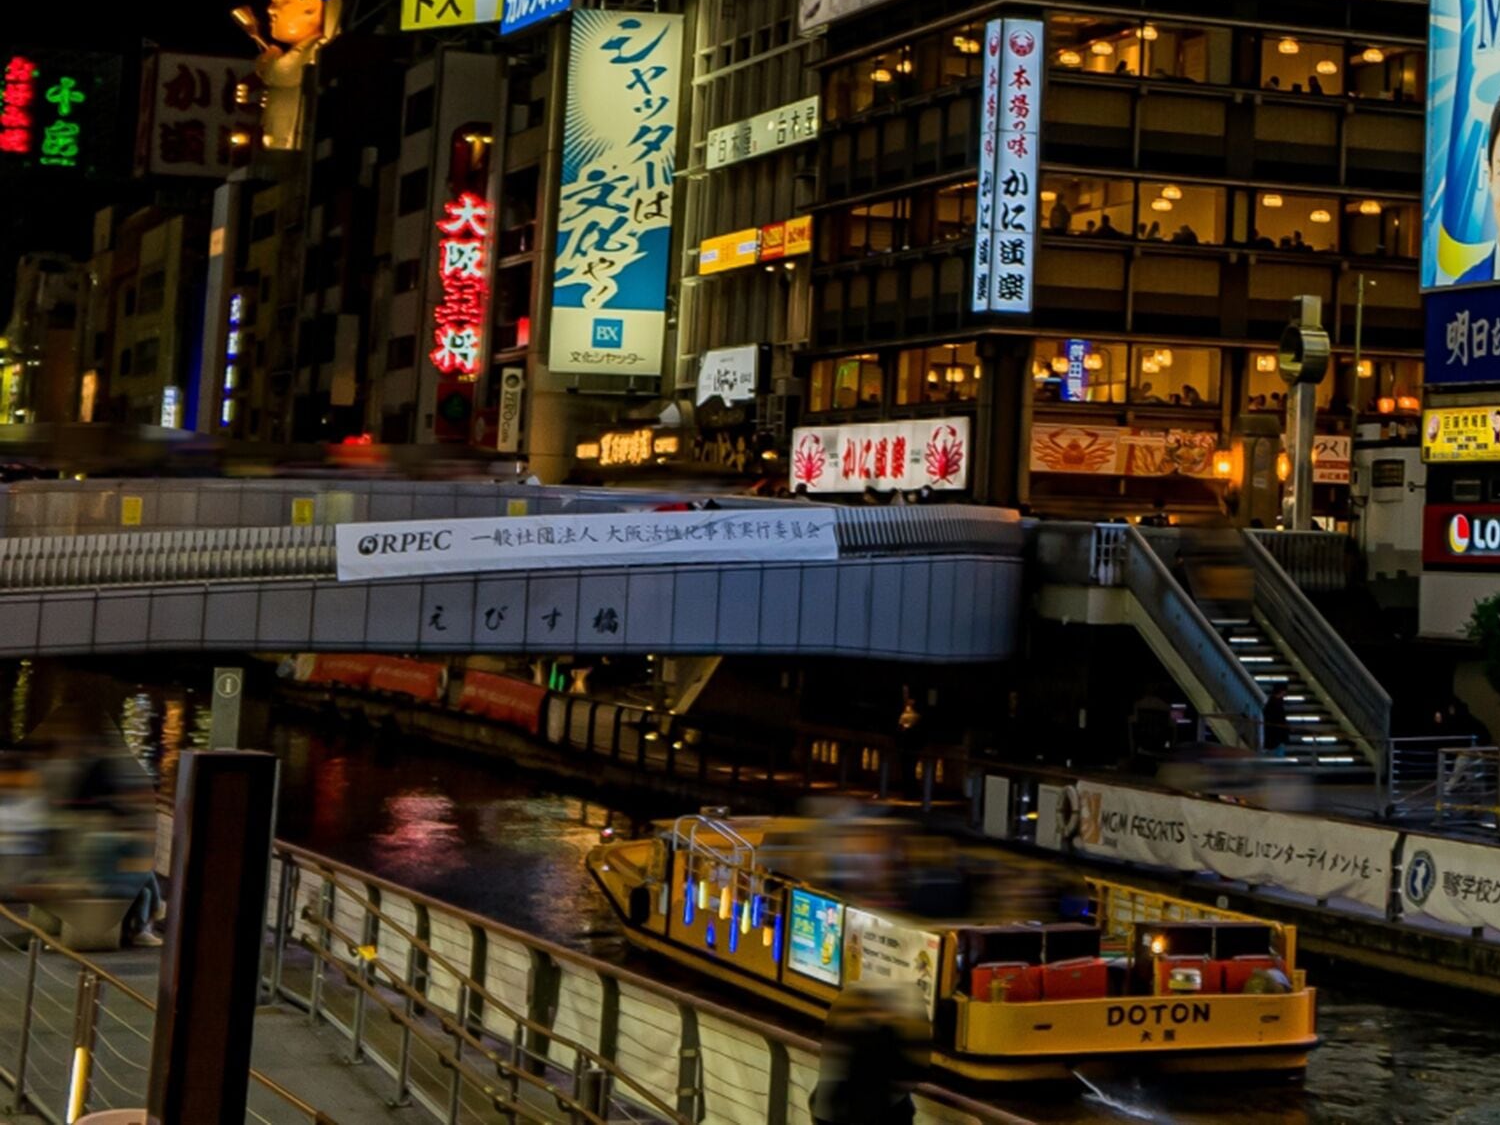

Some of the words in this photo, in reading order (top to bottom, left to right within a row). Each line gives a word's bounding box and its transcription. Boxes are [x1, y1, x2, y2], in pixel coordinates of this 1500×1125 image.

[1007, 65, 1031, 158] 本場の味
[436, 192, 488, 370] 大阪王将
[595, 327, 619, 341] BX
[471, 526, 598, 548] 一般社団法人
[1106, 1002, 1211, 1028] DOTON
[1139, 1028, 1178, 1044] 大阪
